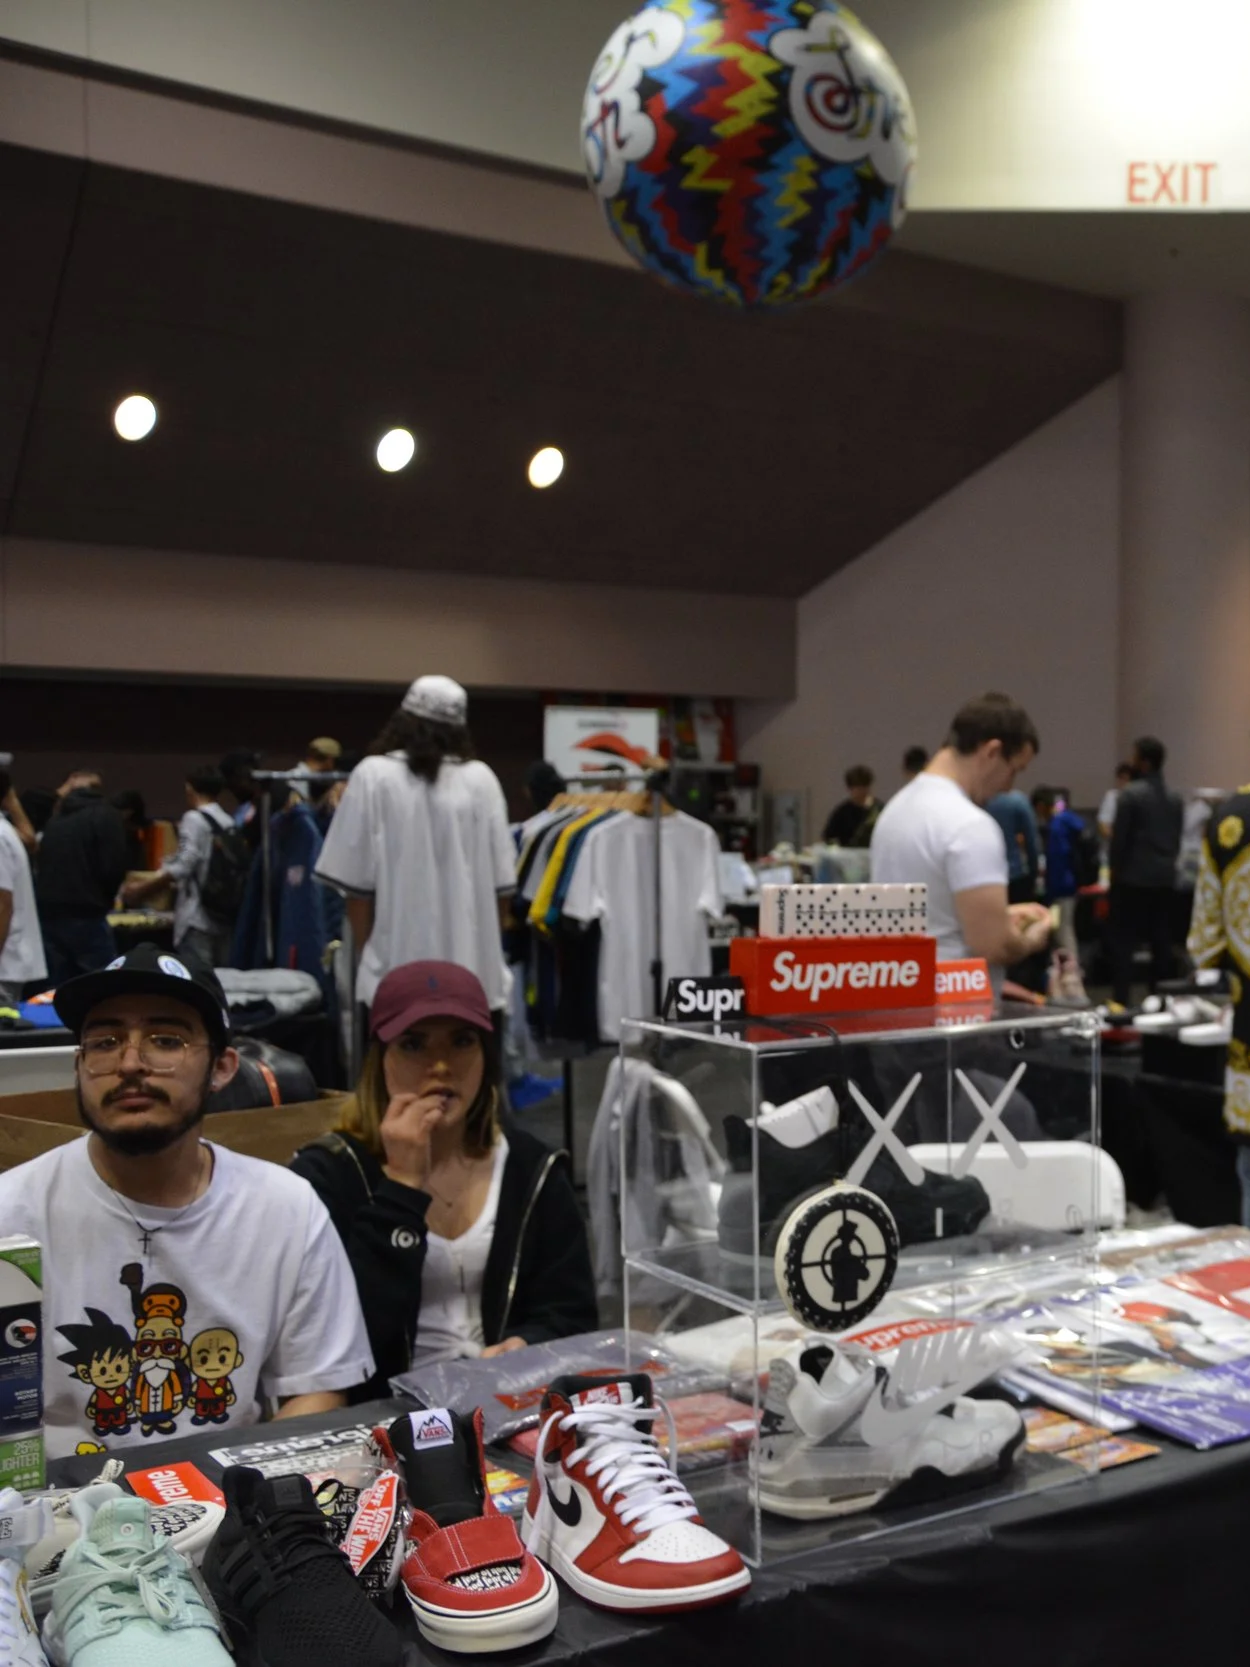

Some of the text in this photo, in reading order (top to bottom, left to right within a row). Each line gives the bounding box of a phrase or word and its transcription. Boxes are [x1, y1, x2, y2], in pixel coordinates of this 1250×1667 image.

[1127, 161, 1218, 204] EXIT
[778, 889, 788, 934] Supreme
[770, 951, 920, 1002] Supreme
[422, 1426, 444, 1439] VANS
[353, 1508, 377, 1535] THE
[368, 1507, 392, 1541] VANS
